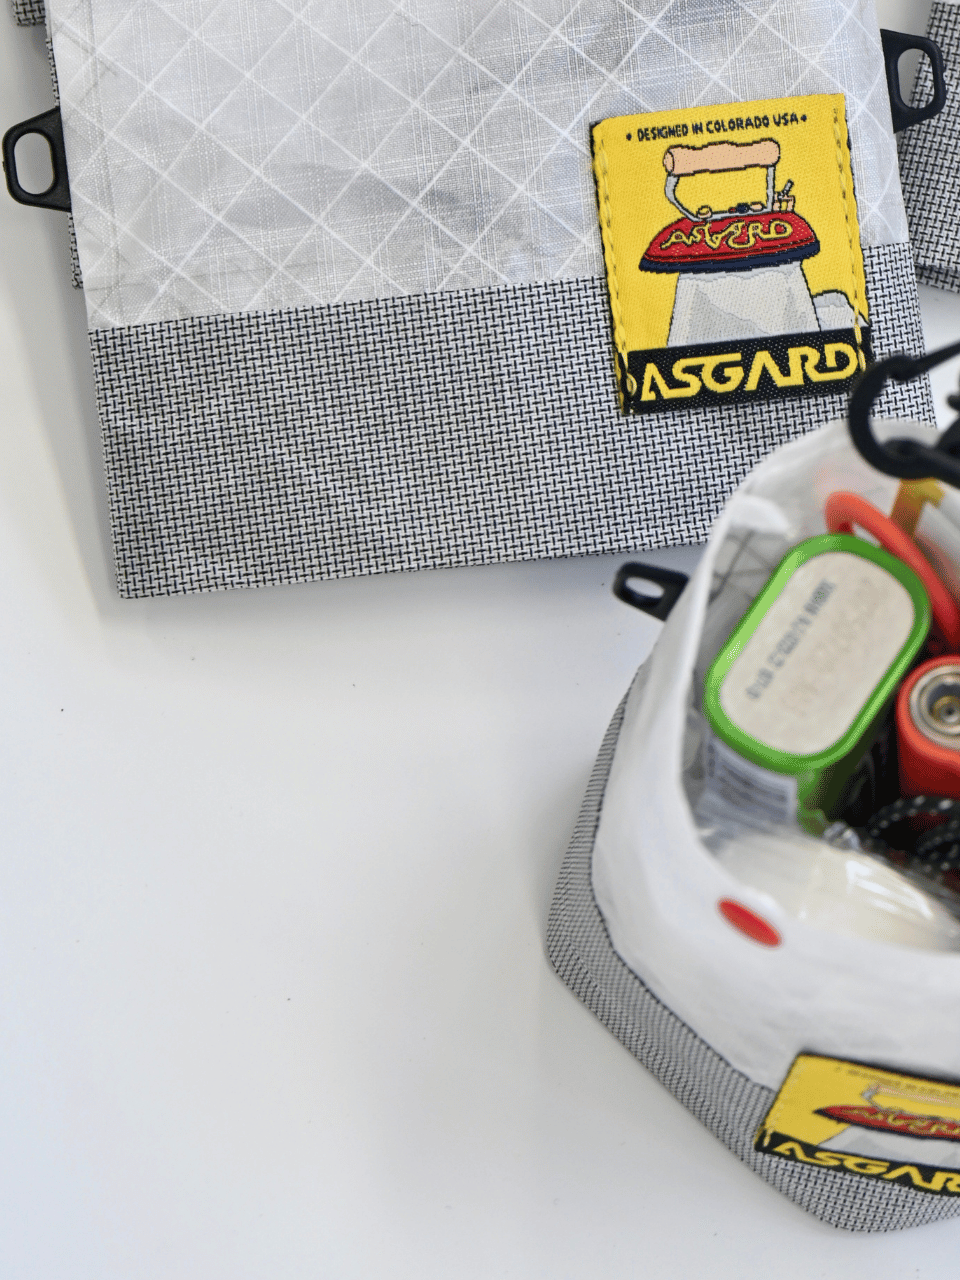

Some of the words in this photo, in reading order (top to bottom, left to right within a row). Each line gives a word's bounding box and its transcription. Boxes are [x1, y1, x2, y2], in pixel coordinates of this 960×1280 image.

[637, 123, 689, 142] DESIGNED
[692, 122, 704, 135] IN
[706, 114, 770, 134] COLORADO
[772, 111, 799, 126] USA
[639, 342, 859, 403] ASGARD
